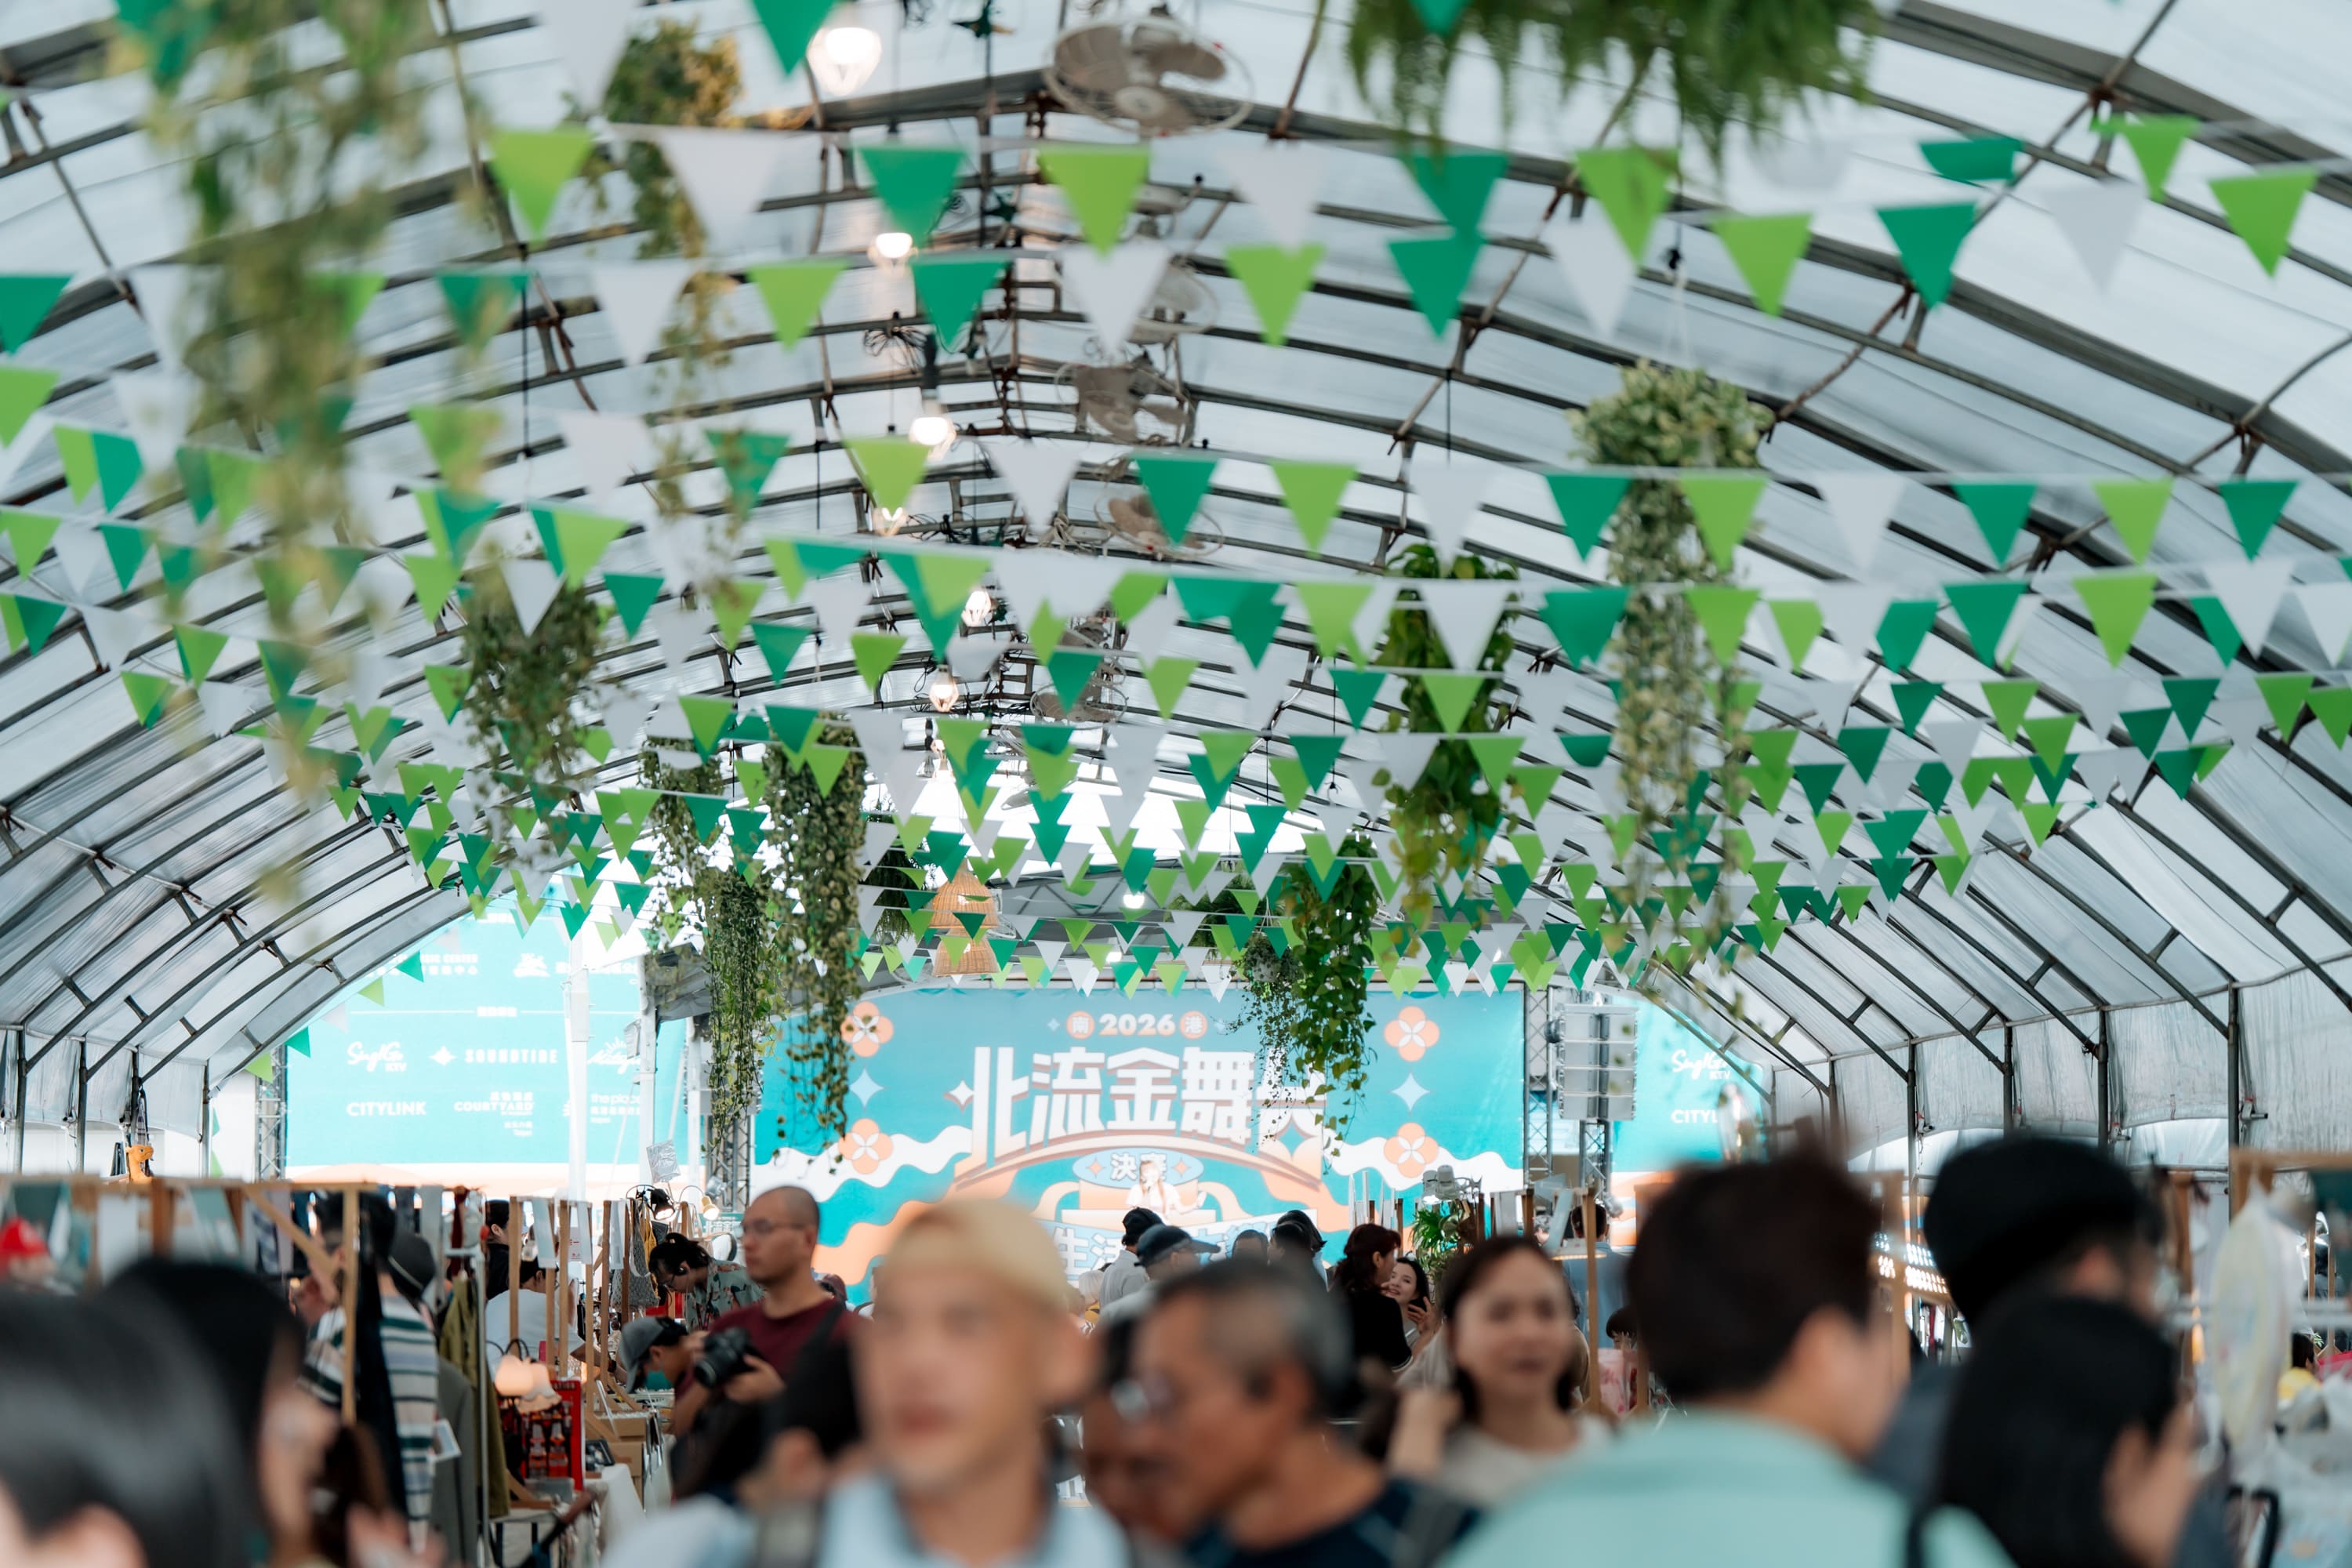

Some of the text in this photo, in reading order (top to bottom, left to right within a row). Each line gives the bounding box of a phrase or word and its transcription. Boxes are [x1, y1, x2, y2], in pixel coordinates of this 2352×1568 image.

[1072, 1014, 1203, 1036] 南 2026 港
[347, 1101, 426, 1117] CITYLINK
[454, 1101, 533, 1112] COURTYARD
[1670, 1109, 1718, 1123] CITYL
